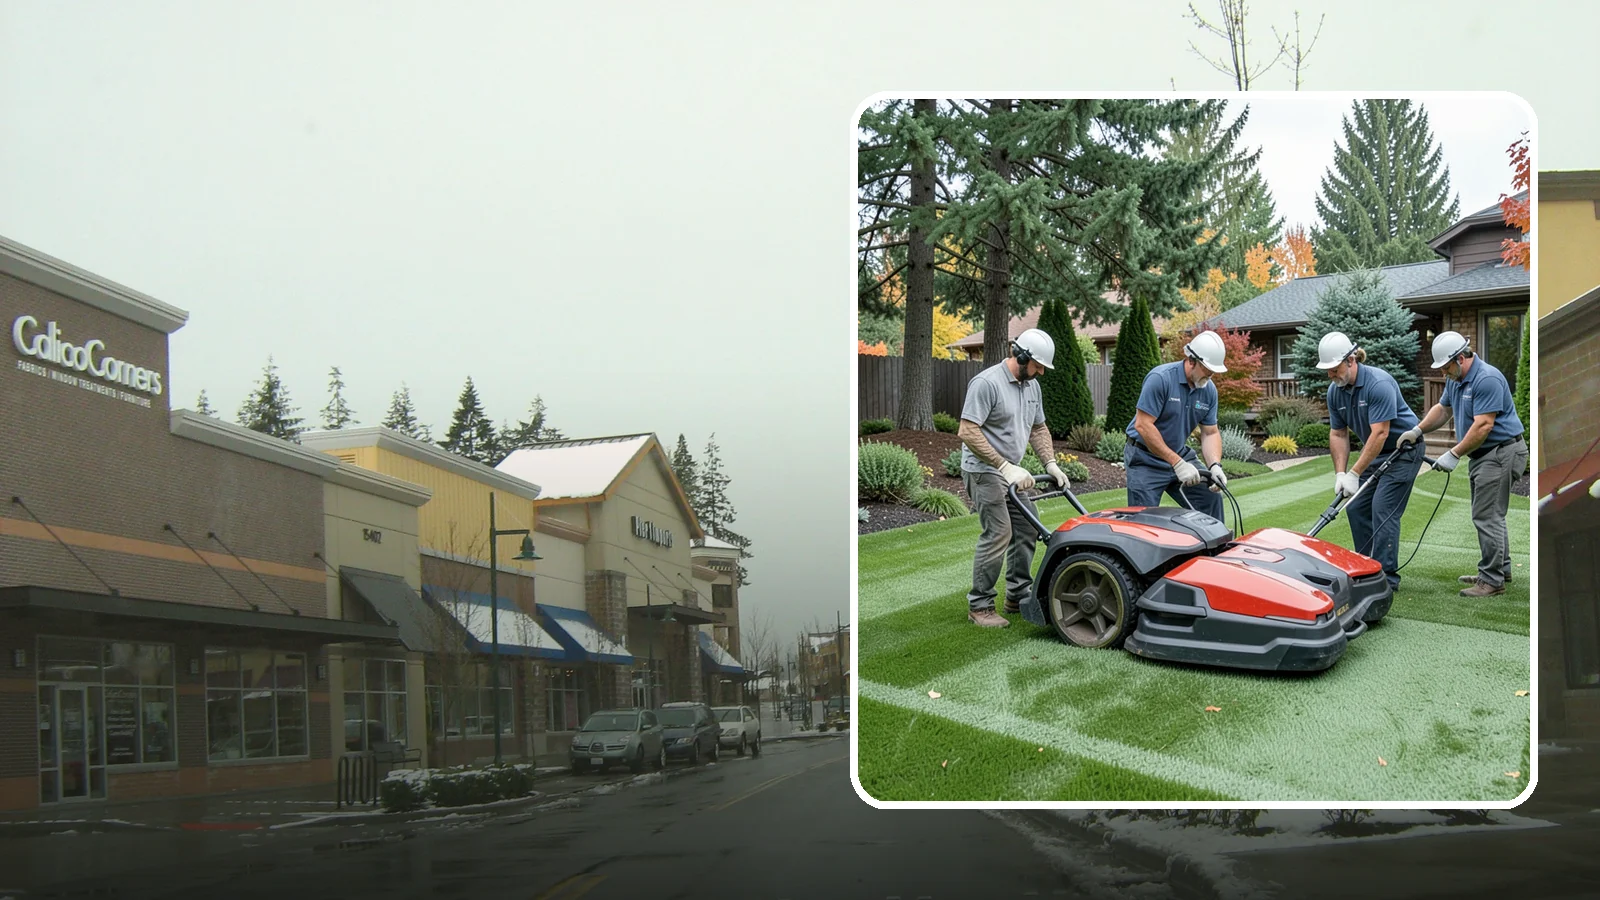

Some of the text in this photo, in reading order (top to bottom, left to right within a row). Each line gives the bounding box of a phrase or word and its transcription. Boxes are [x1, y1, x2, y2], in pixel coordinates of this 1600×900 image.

[16, 360, 47, 377] FABRICS
[51, 370, 78, 387] WINDOW
[79, 379, 116, 398] TREATMENTS
[120, 391, 151, 408] FURNITURE
